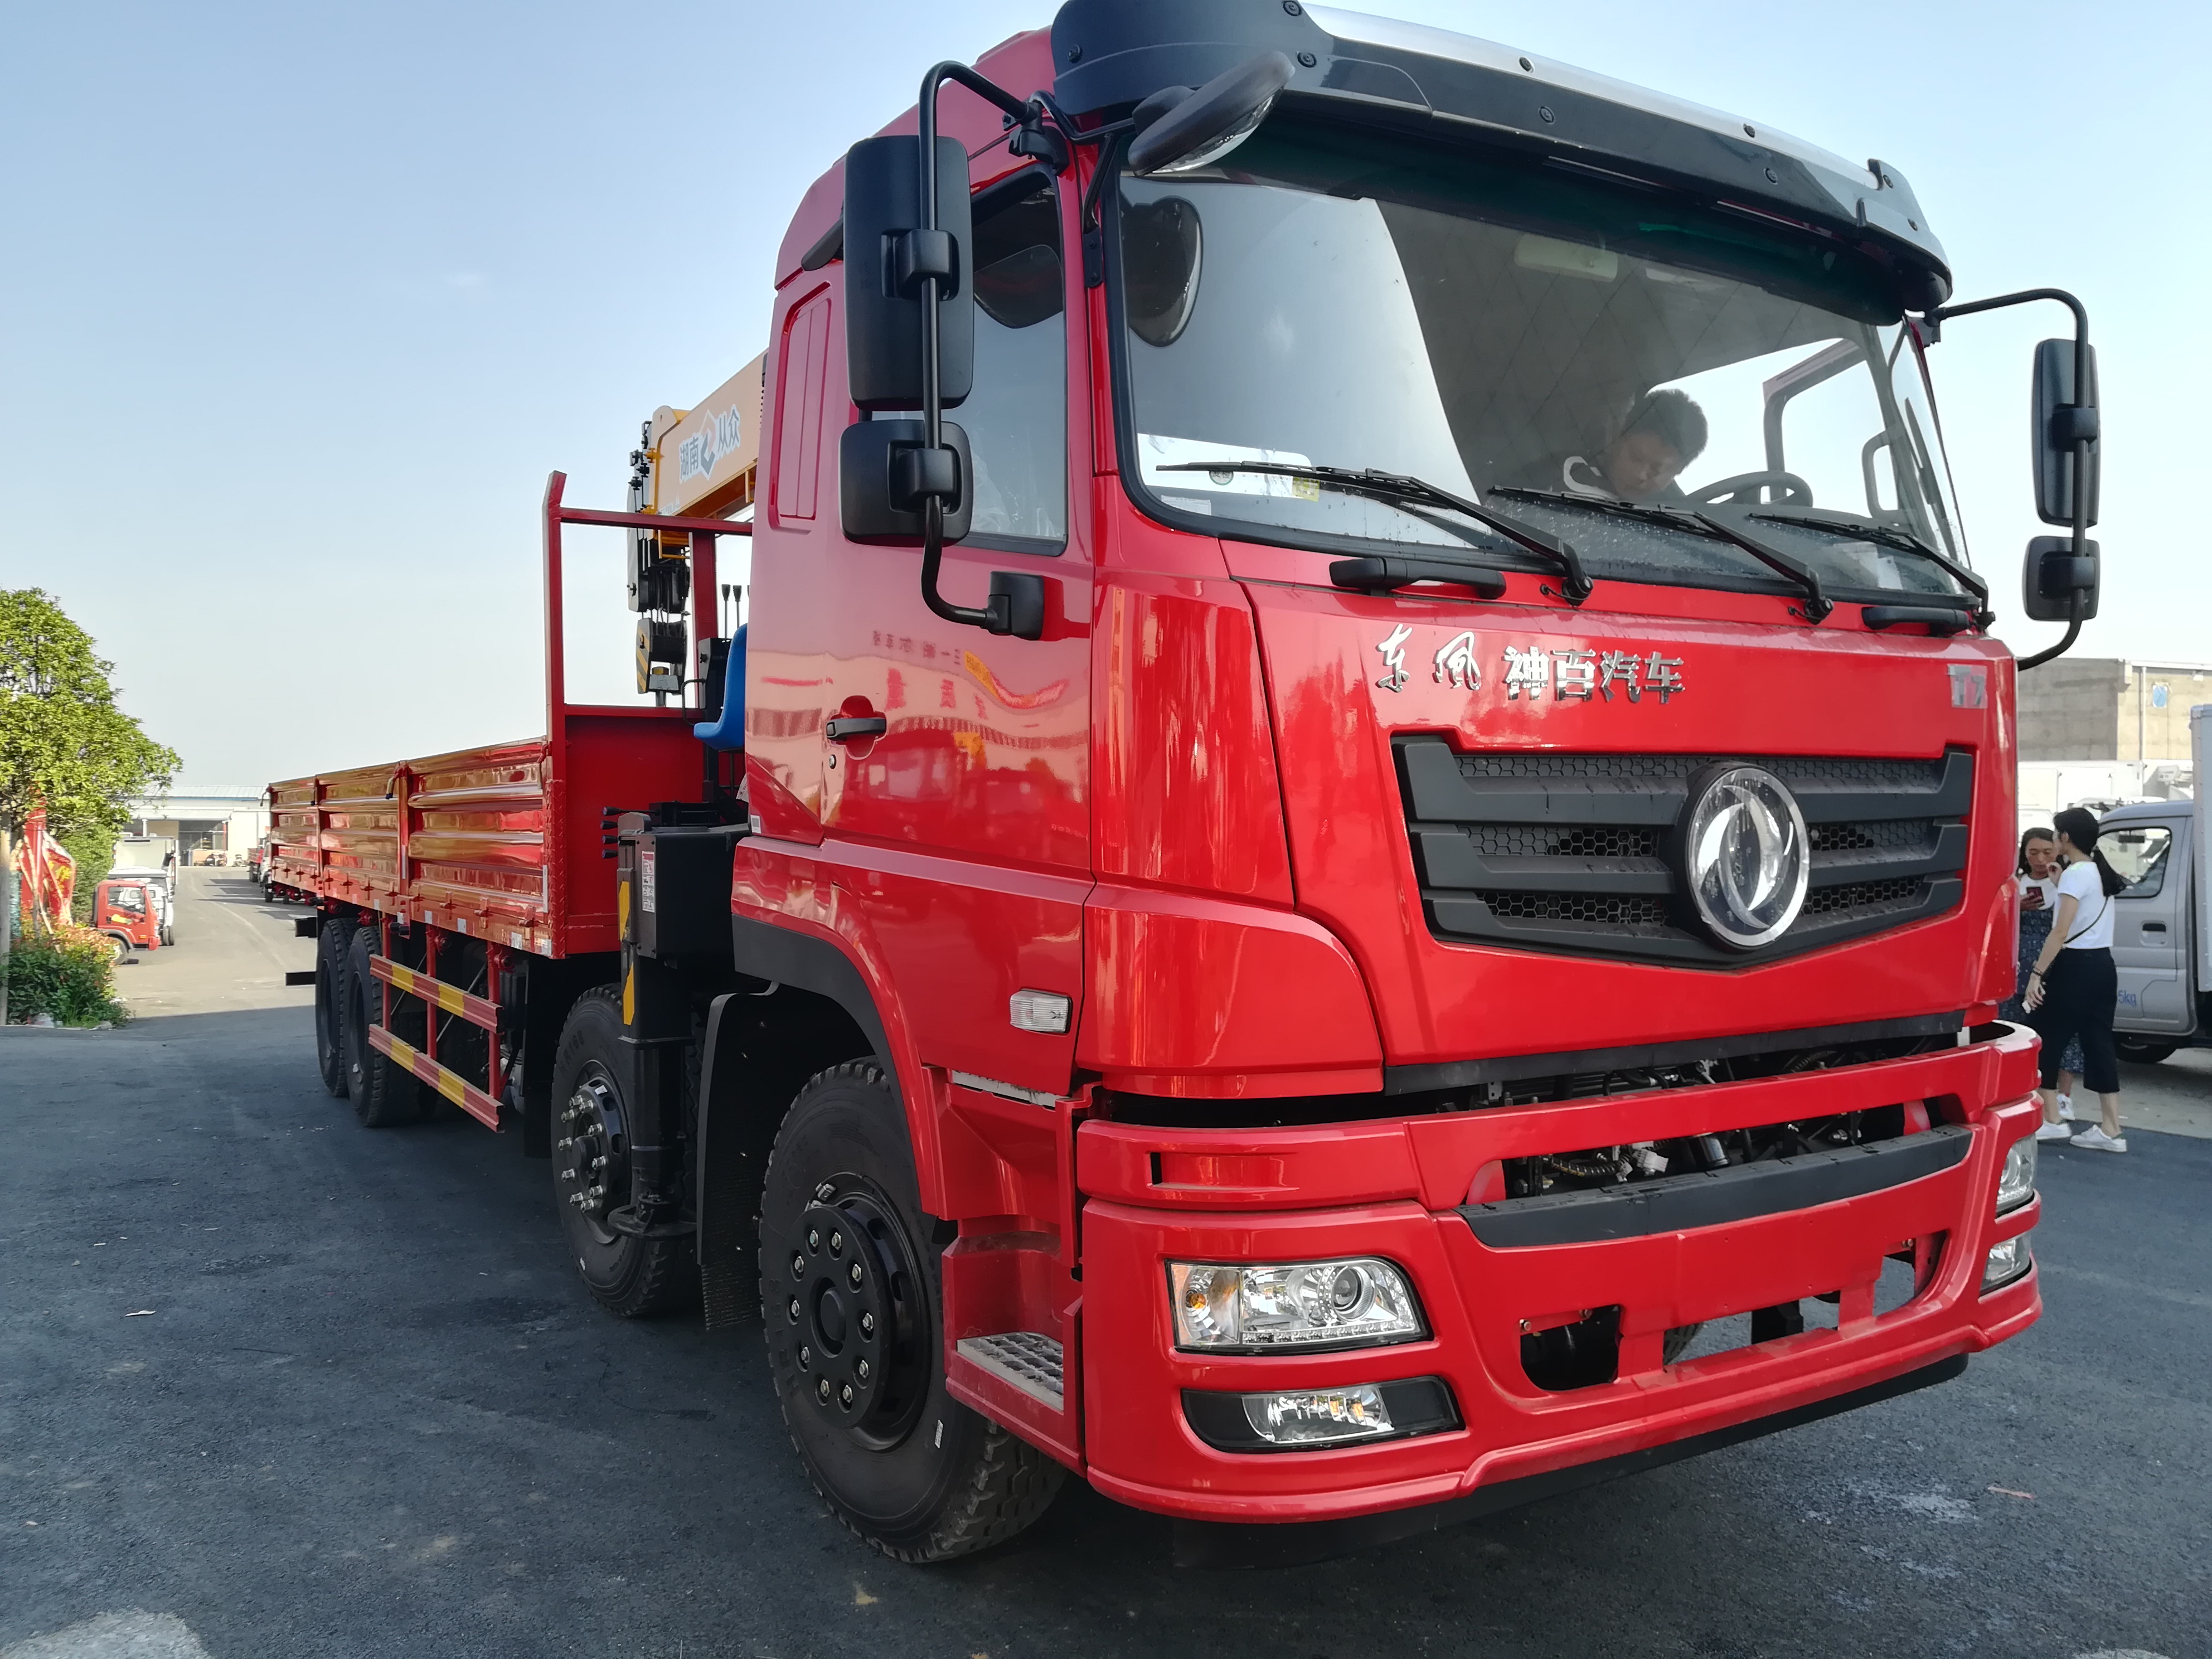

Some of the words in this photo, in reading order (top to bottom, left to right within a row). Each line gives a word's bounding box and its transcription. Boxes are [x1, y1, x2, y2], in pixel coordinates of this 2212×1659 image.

[680, 436, 698, 480] 湖南
[717, 409, 739, 453] 从众
[1948, 664, 1984, 706] T7
